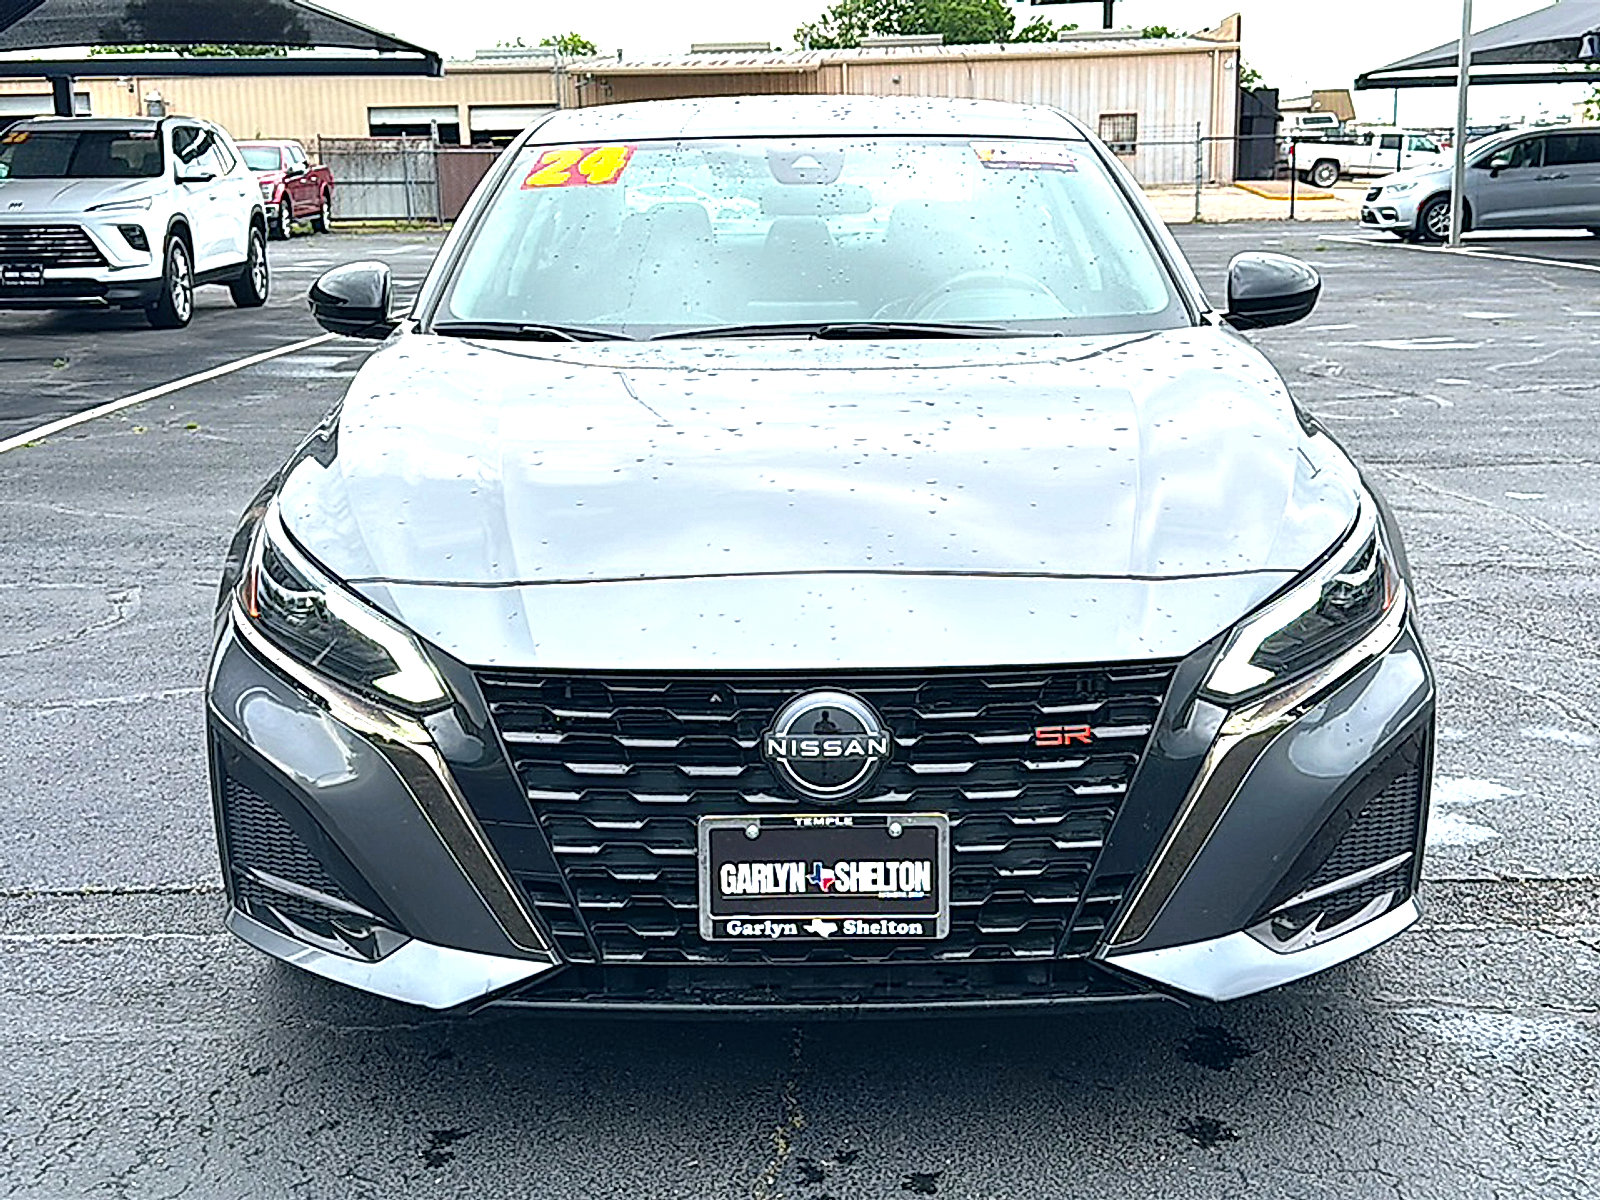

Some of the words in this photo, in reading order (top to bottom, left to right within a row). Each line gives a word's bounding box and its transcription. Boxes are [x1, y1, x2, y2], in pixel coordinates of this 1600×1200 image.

[525, 146, 629, 185] 24
[1035, 724, 1093, 746] SR
[767, 738, 887, 757] NISSAN
[794, 816, 853, 827] TEMPLE
[720, 861, 806, 895] GARLYN
[834, 861, 931, 892] SHELTON
[726, 920, 798, 938] Garlyn
[843, 918, 923, 936] Shelton
